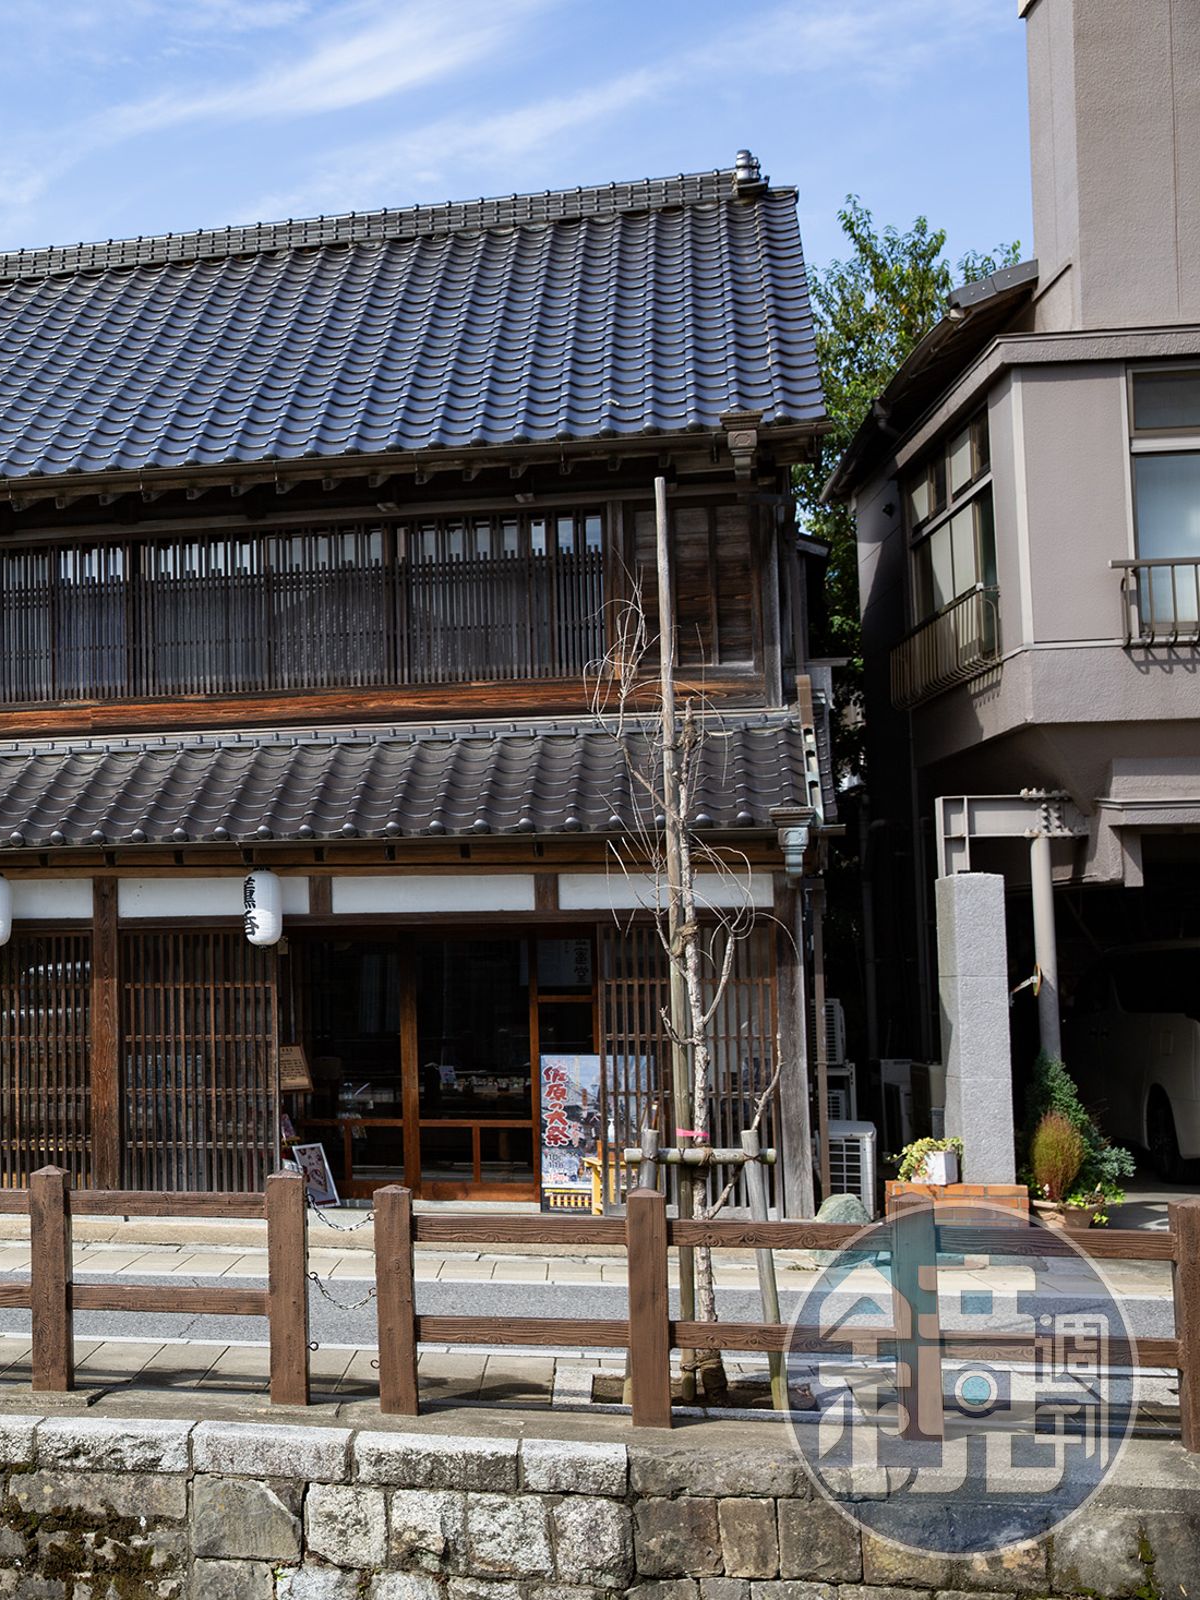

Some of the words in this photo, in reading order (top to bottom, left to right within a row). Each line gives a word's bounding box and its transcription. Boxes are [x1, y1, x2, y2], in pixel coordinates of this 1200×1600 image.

[542, 1065, 570, 1147] 佐原の大祭
